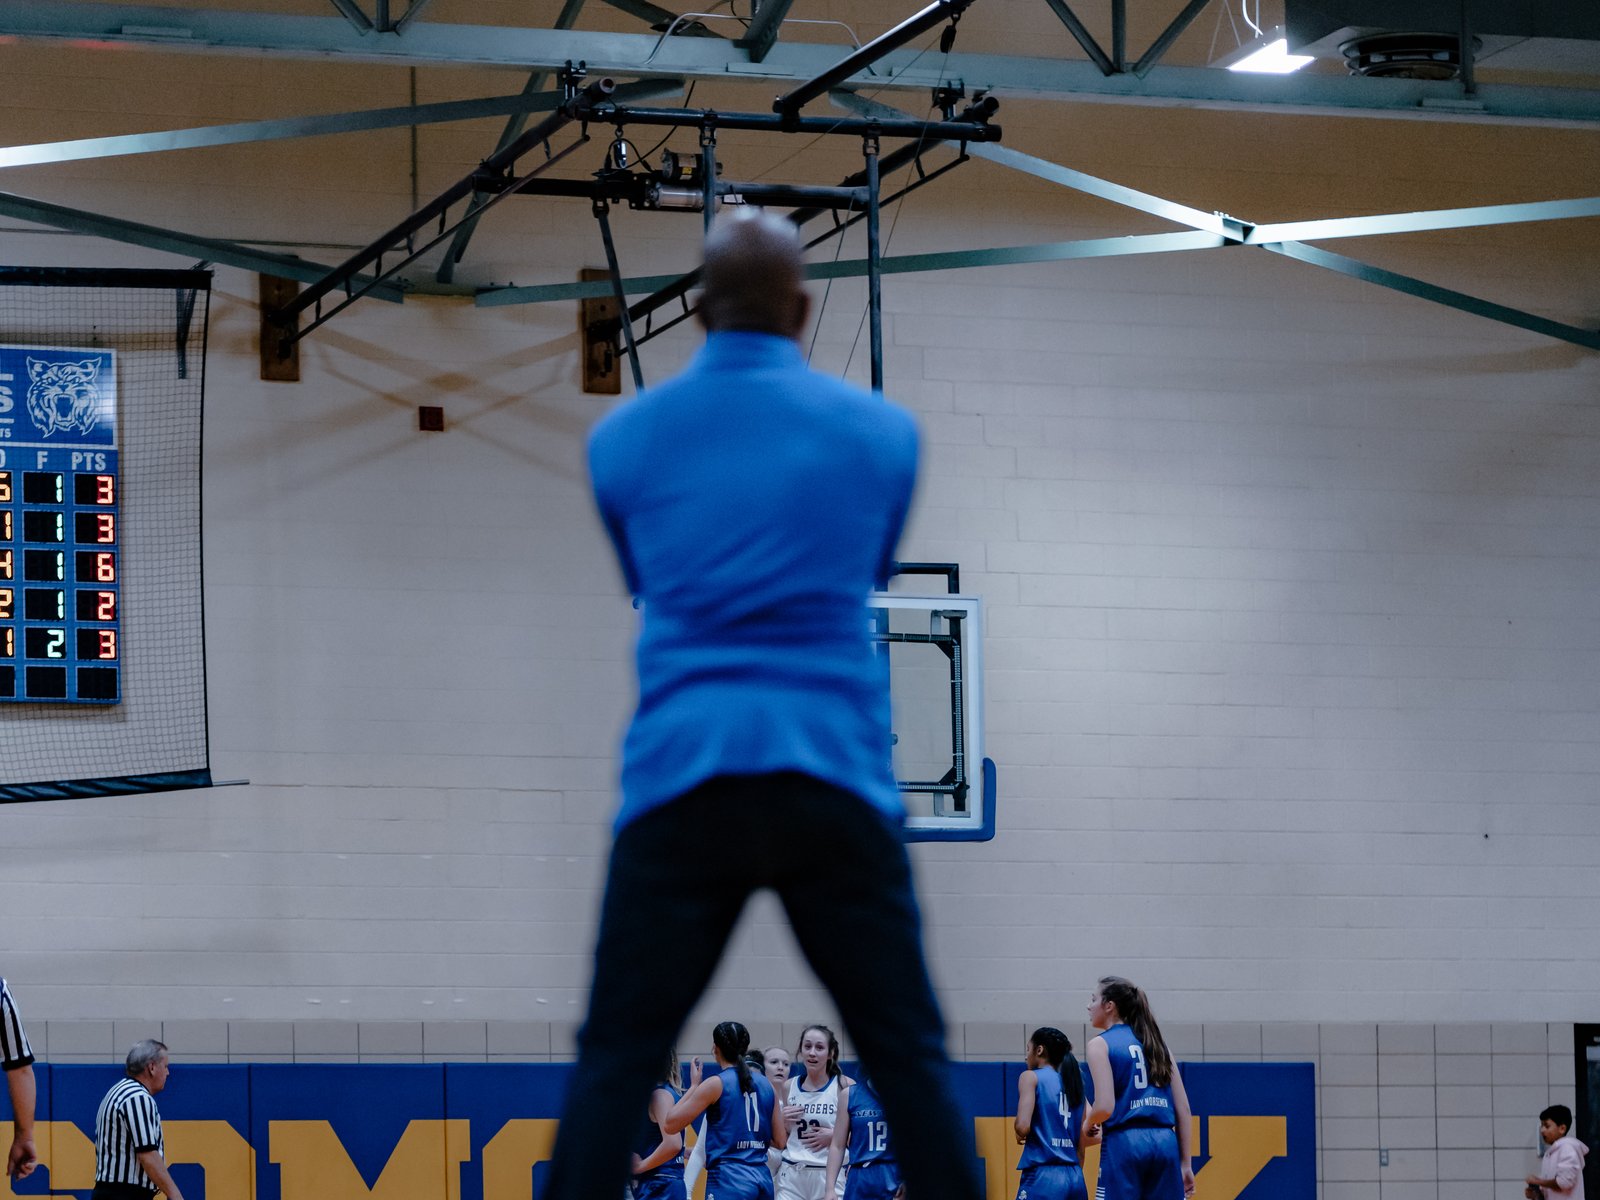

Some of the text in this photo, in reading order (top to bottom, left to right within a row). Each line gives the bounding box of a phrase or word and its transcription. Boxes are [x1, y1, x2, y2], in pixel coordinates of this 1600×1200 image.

[37, 451, 107, 471] F PTS
[56, 475, 113, 504] 1 3
[56, 513, 63, 541] 1
[97, 514, 113, 542] 3
[57, 552, 63, 580] 1
[97, 553, 114, 581] 6
[57, 591, 64, 619] 1
[98, 592, 114, 620] 2
[47, 629, 65, 658] 2
[99, 630, 115, 658] 3
[1128, 1045, 1148, 1089] 3
[743, 1091, 760, 1132] 11
[791, 1103, 834, 1114] RGERS
[1059, 1092, 1071, 1130] 4
[1130, 1099, 1144, 1110] LADY
[867, 1121, 887, 1151] 12
